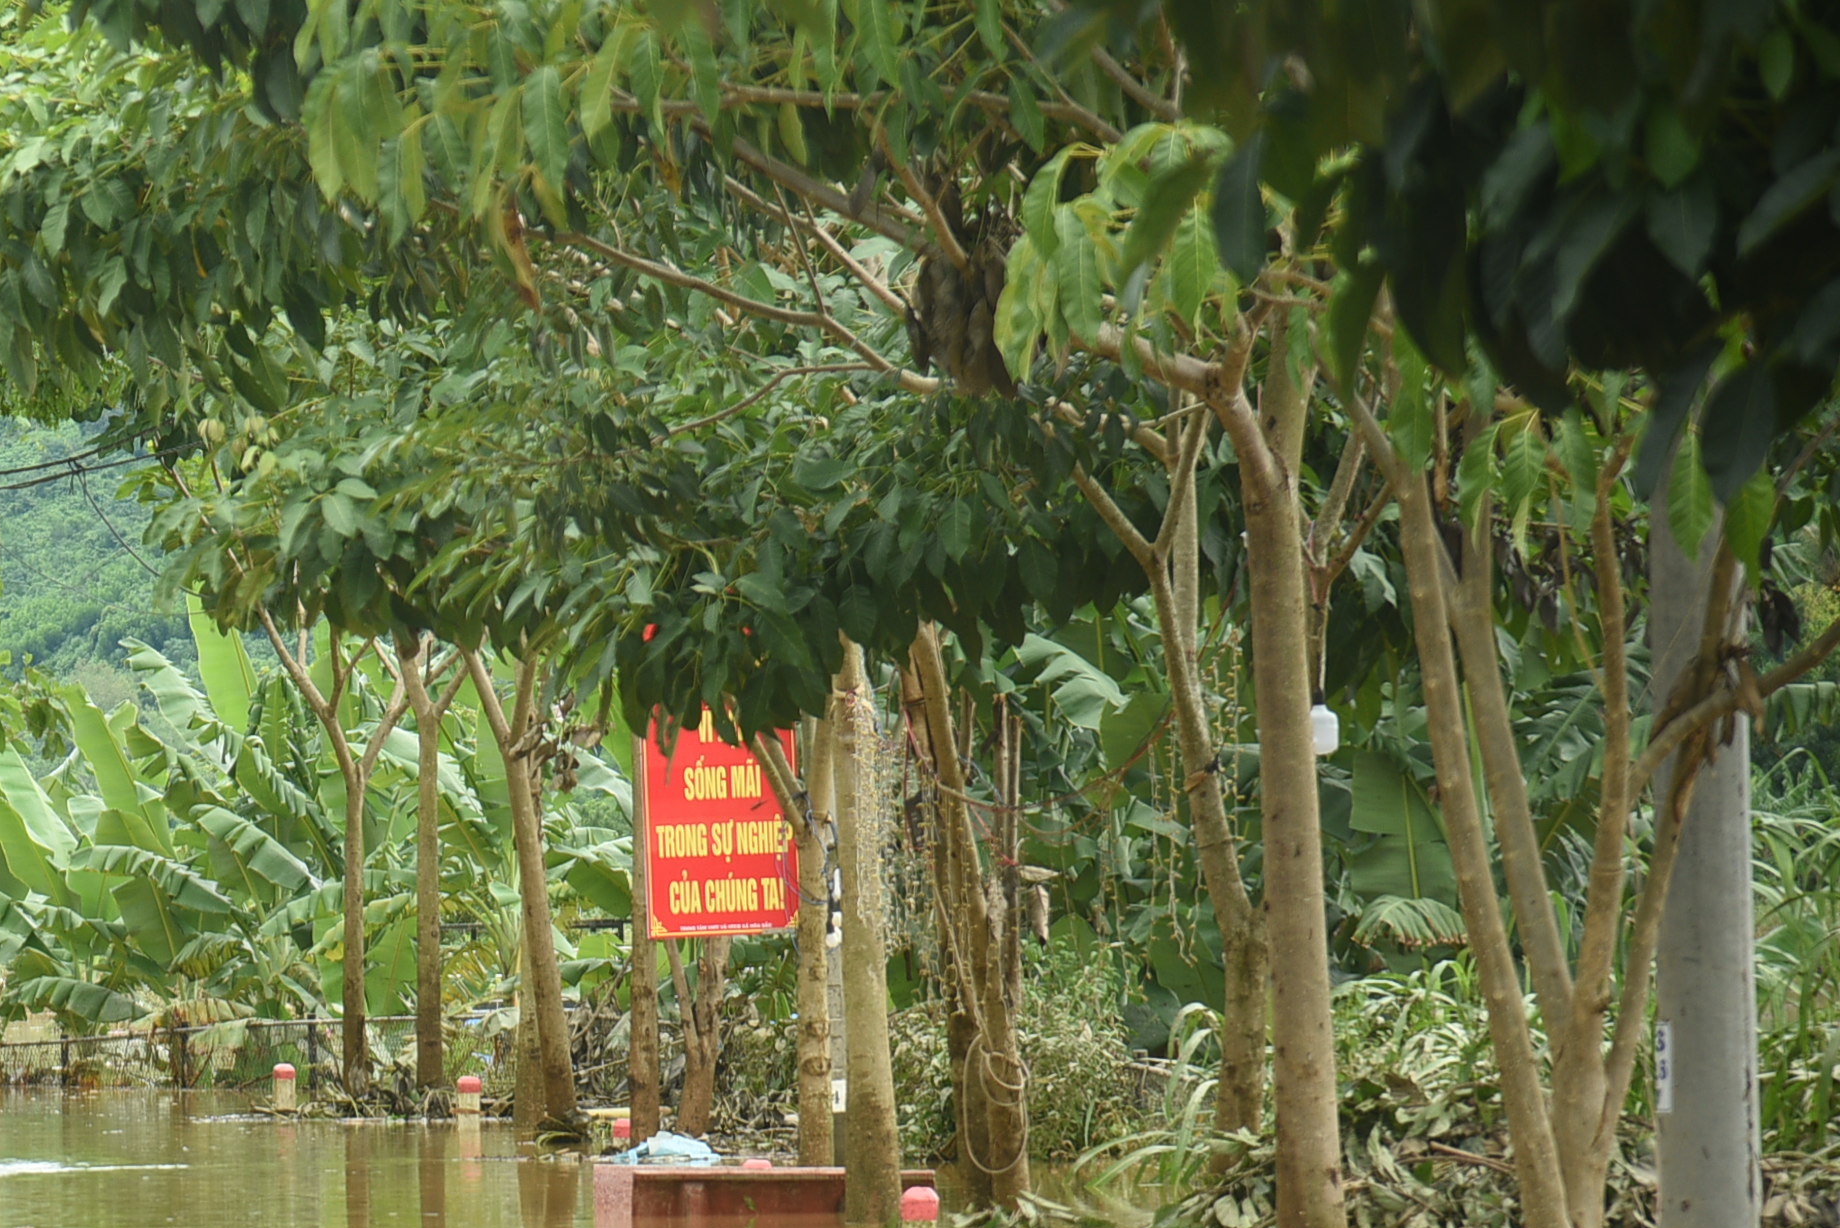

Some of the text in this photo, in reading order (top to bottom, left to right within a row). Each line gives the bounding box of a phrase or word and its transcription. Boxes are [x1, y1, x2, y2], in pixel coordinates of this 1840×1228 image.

[684, 754, 762, 801] SỐNG MÃI
[655, 813, 794, 863] TRONG SỰ NGHIỆP
[668, 869, 786, 915] CỦA CHÚNG TA!
